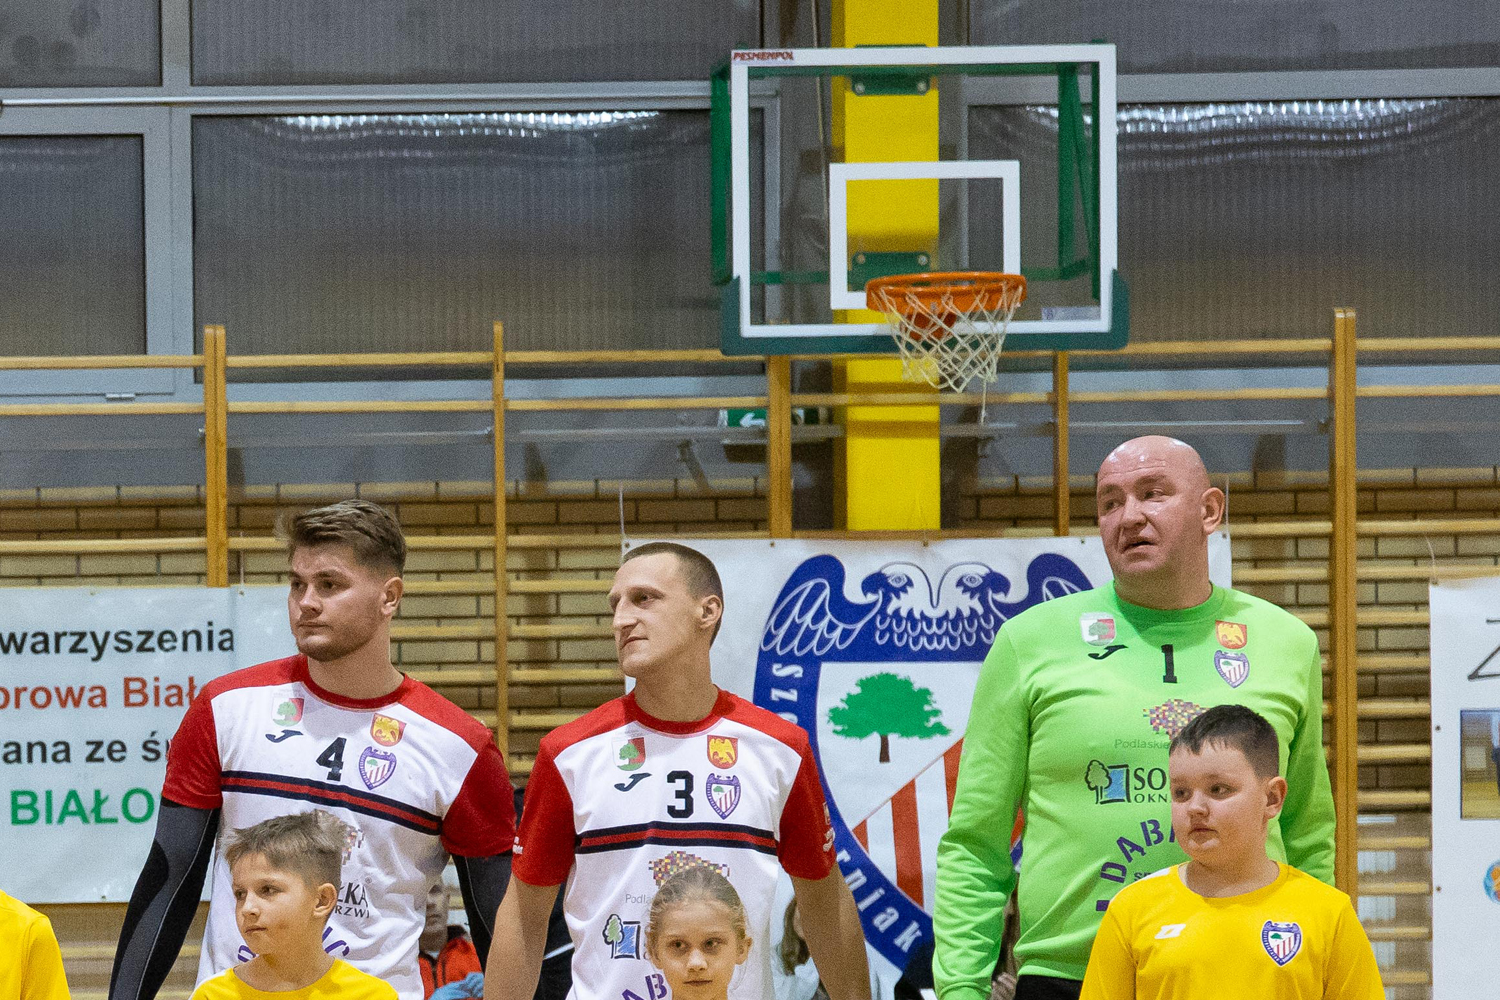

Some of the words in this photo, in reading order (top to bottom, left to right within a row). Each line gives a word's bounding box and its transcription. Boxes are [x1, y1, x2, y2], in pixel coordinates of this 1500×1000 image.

[1161, 644, 1177, 683] 1
[123, 676, 205, 707] Biał
[85, 739, 127, 763] ze
[1113, 738, 1169, 750] Podlaskie
[316, 736, 347, 781] 4
[1133, 767, 1167, 791] SO
[10, 787, 155, 825] BIAŁO
[667, 770, 694, 818] 3
[1134, 793, 1168, 803] OKN
[334, 906, 370, 919] RZWI
